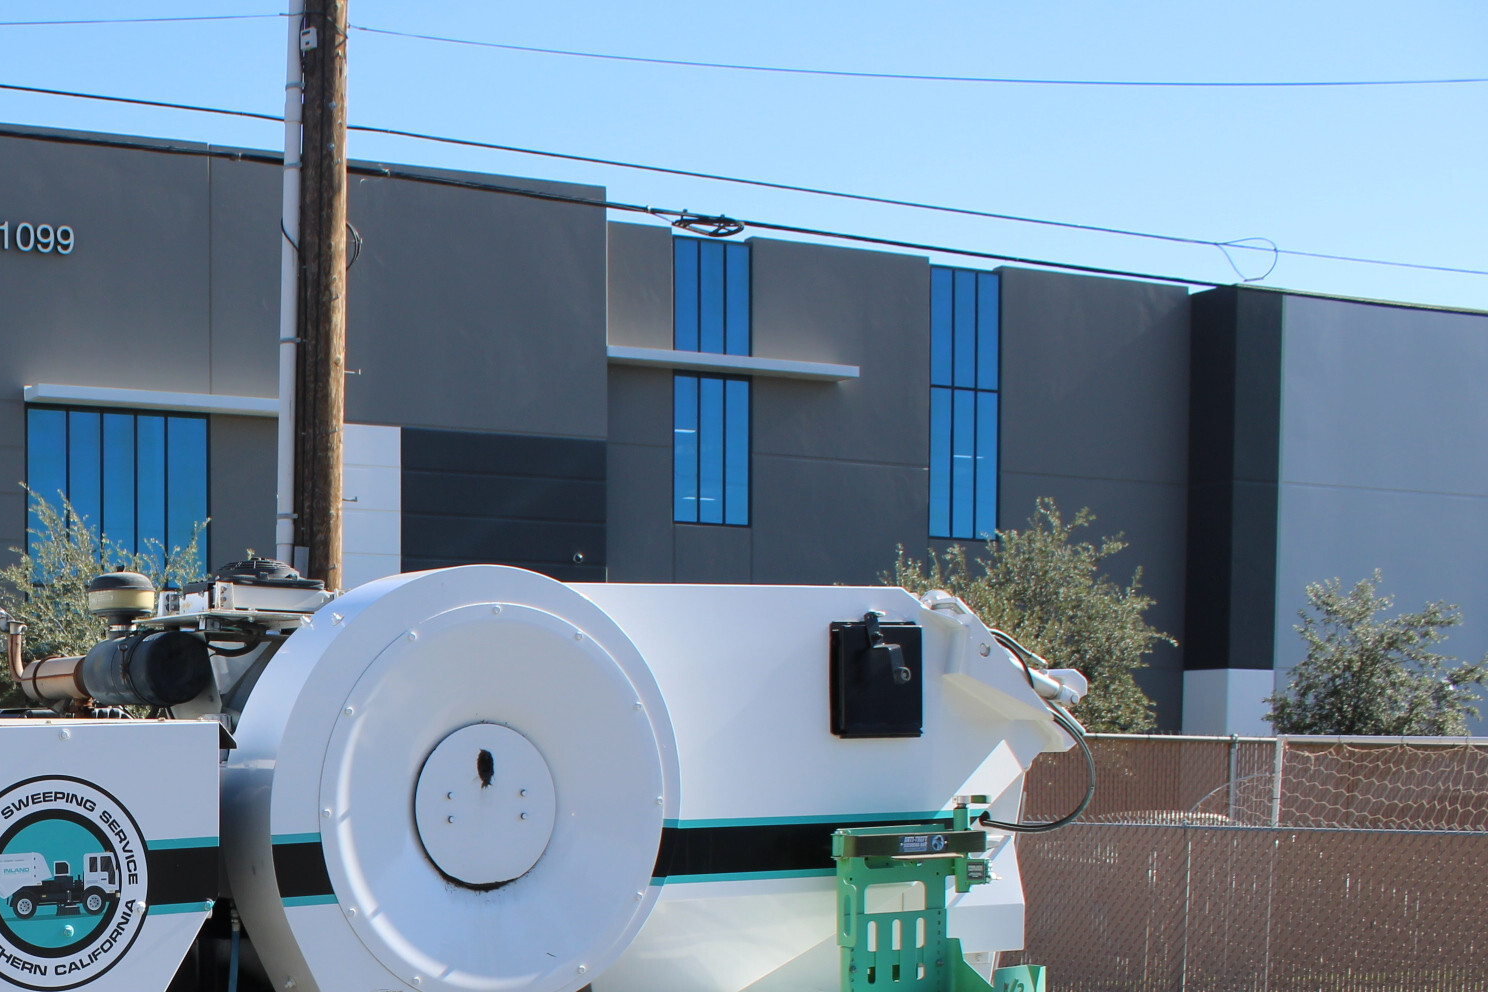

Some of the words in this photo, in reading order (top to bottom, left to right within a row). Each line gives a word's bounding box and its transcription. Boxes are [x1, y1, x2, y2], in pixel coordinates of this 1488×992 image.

[0, 791, 97, 820] SWEEPING
[99, 810, 138, 885] SERVICE
[55, 899, 137, 976] CALIFORNIA
